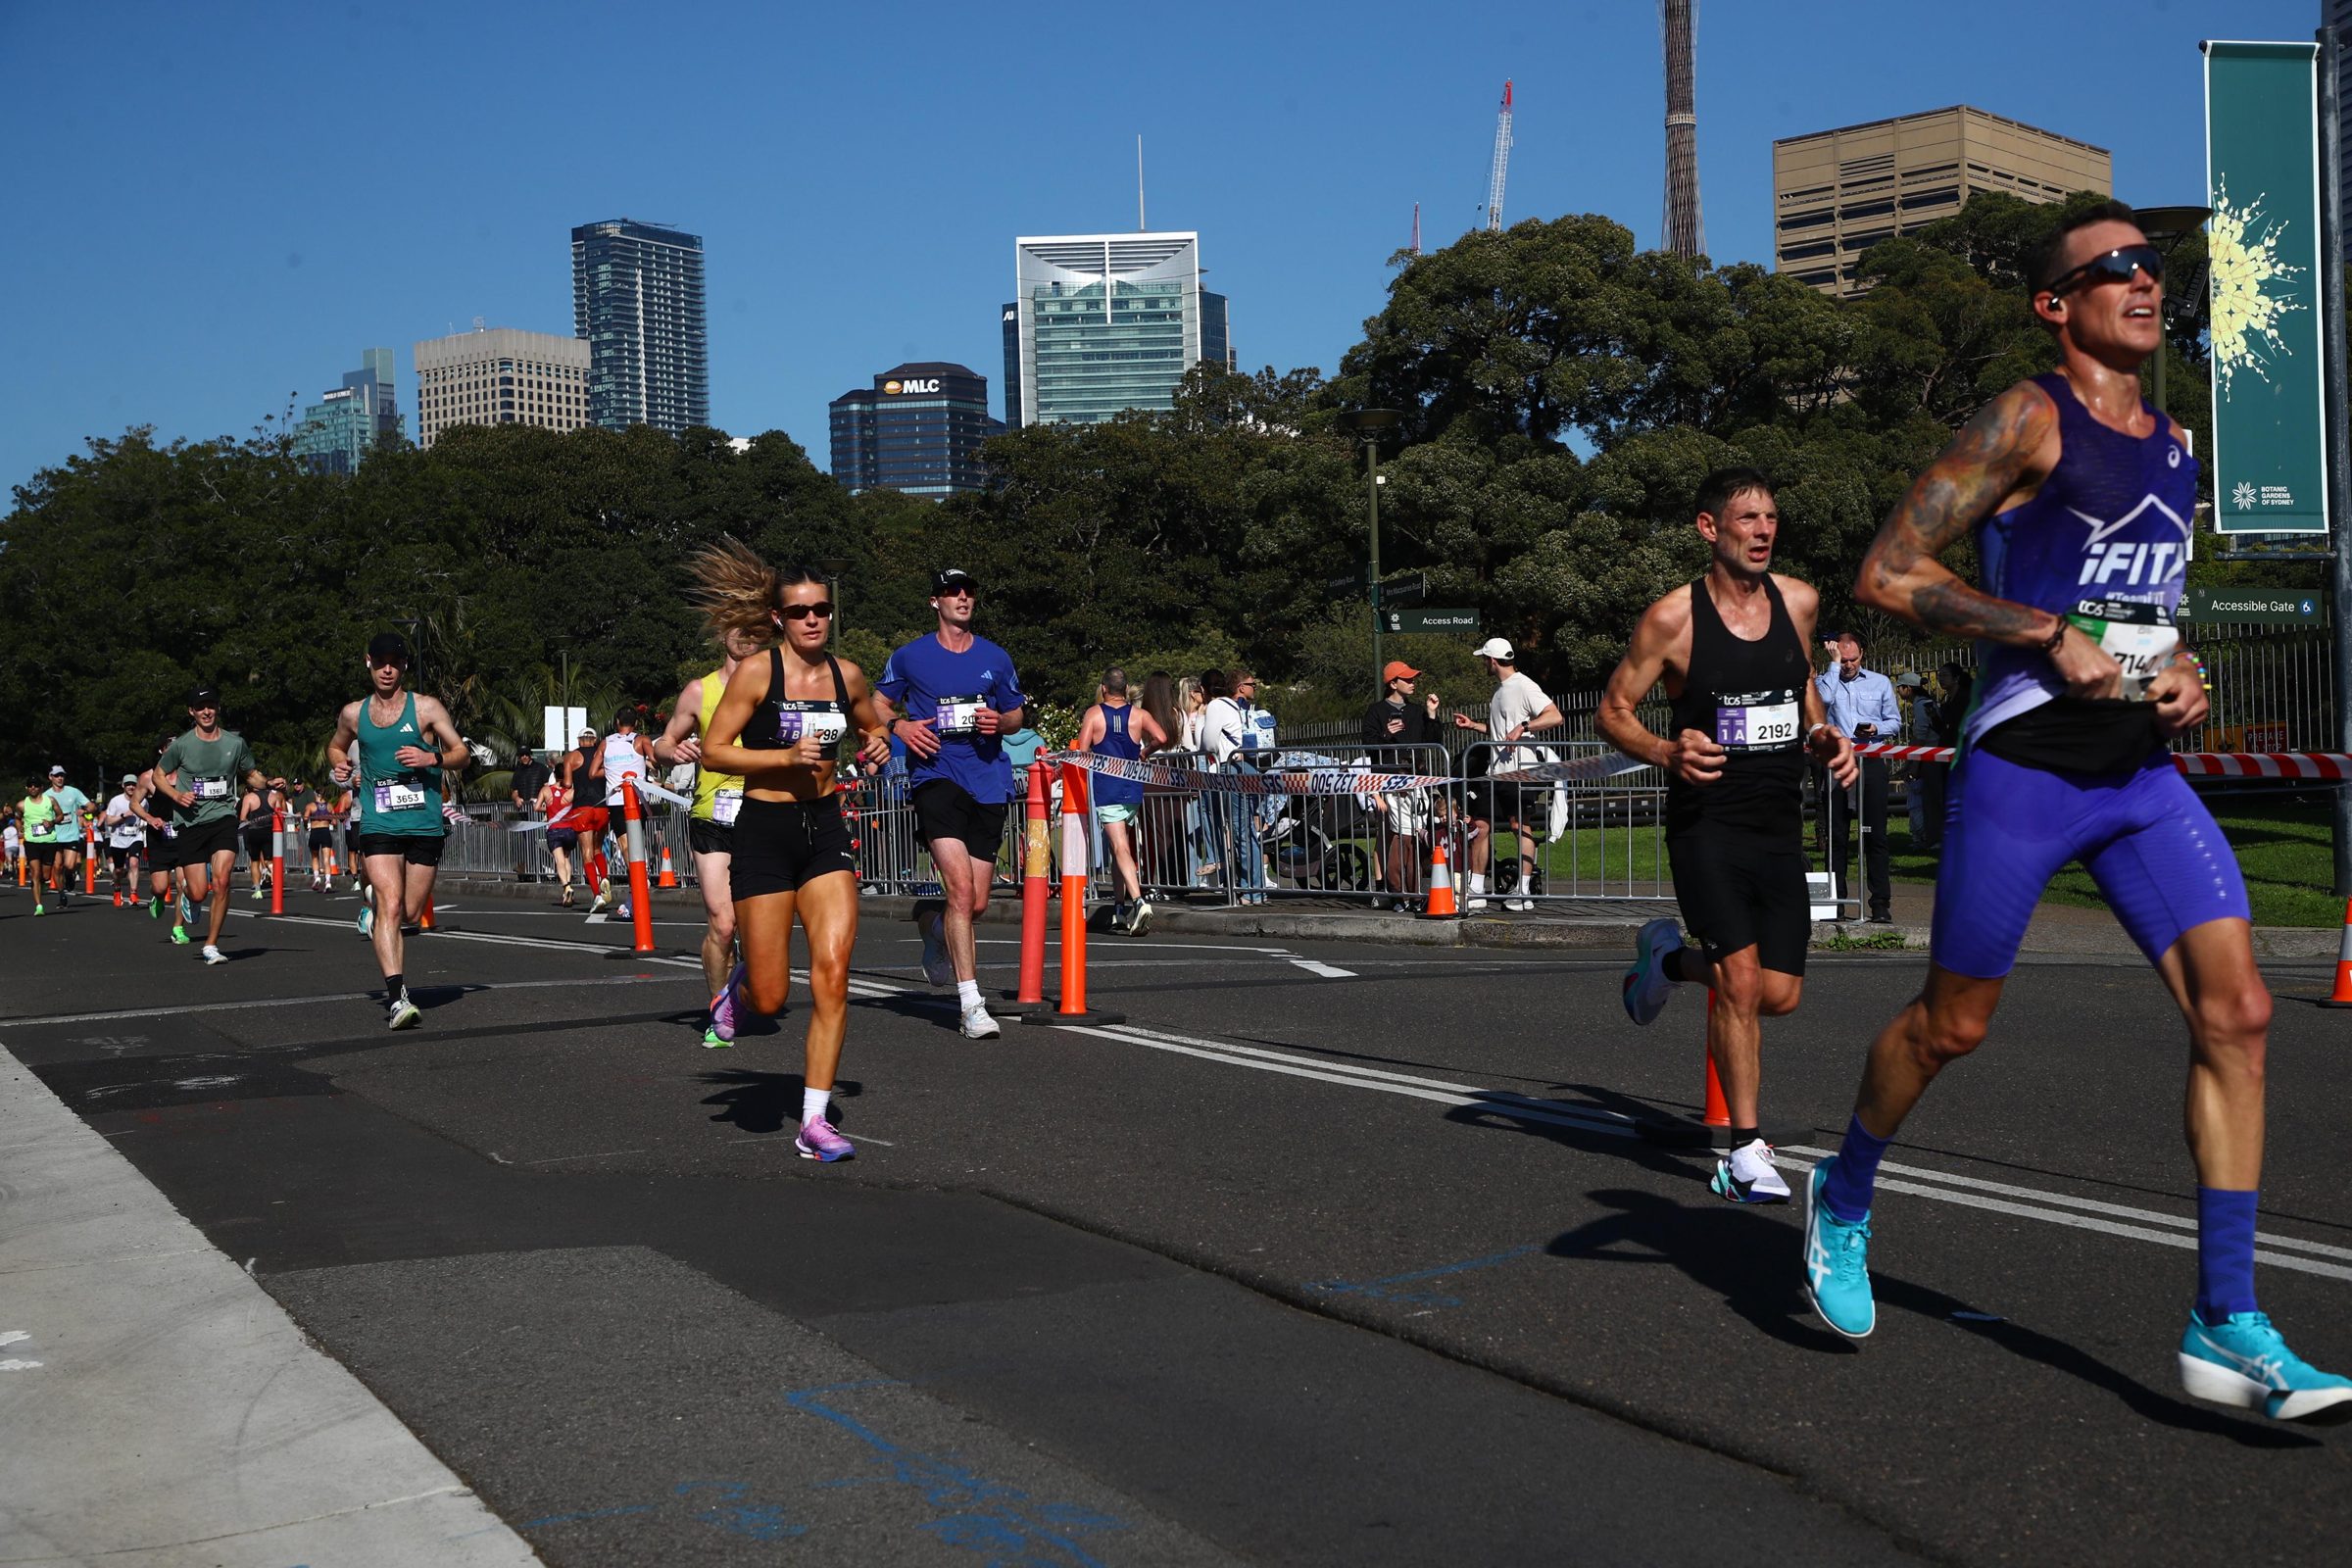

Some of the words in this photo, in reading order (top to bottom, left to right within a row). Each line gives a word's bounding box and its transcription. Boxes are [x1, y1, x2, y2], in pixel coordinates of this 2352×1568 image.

[903, 378, 940, 394] MLC
[2211, 599, 2268, 612] Accessible
[2270, 601, 2295, 612] Gate
[1422, 616, 1451, 625] Access
[1452, 616, 1474, 625] Road
[1724, 695, 1740, 706] tcs
[948, 717, 955, 726] A
[782, 729, 788, 738] 1
[792, 730, 801, 740] B
[1722, 728, 1728, 740] 1
[1735, 729, 1745, 741] A
[1757, 722, 1792, 740] 2192
[1089, 755, 1108, 771] SES
[1123, 760, 1140, 780] 500
[1138, 762, 1152, 783] 132
[1170, 767, 1186, 788] SES
[1261, 773, 1283, 794] SES
[1311, 773, 1334, 794] 500
[1334, 773, 1357, 794] 132
[1382, 775, 1415, 790] SES
[396, 793, 419, 804] 3653
